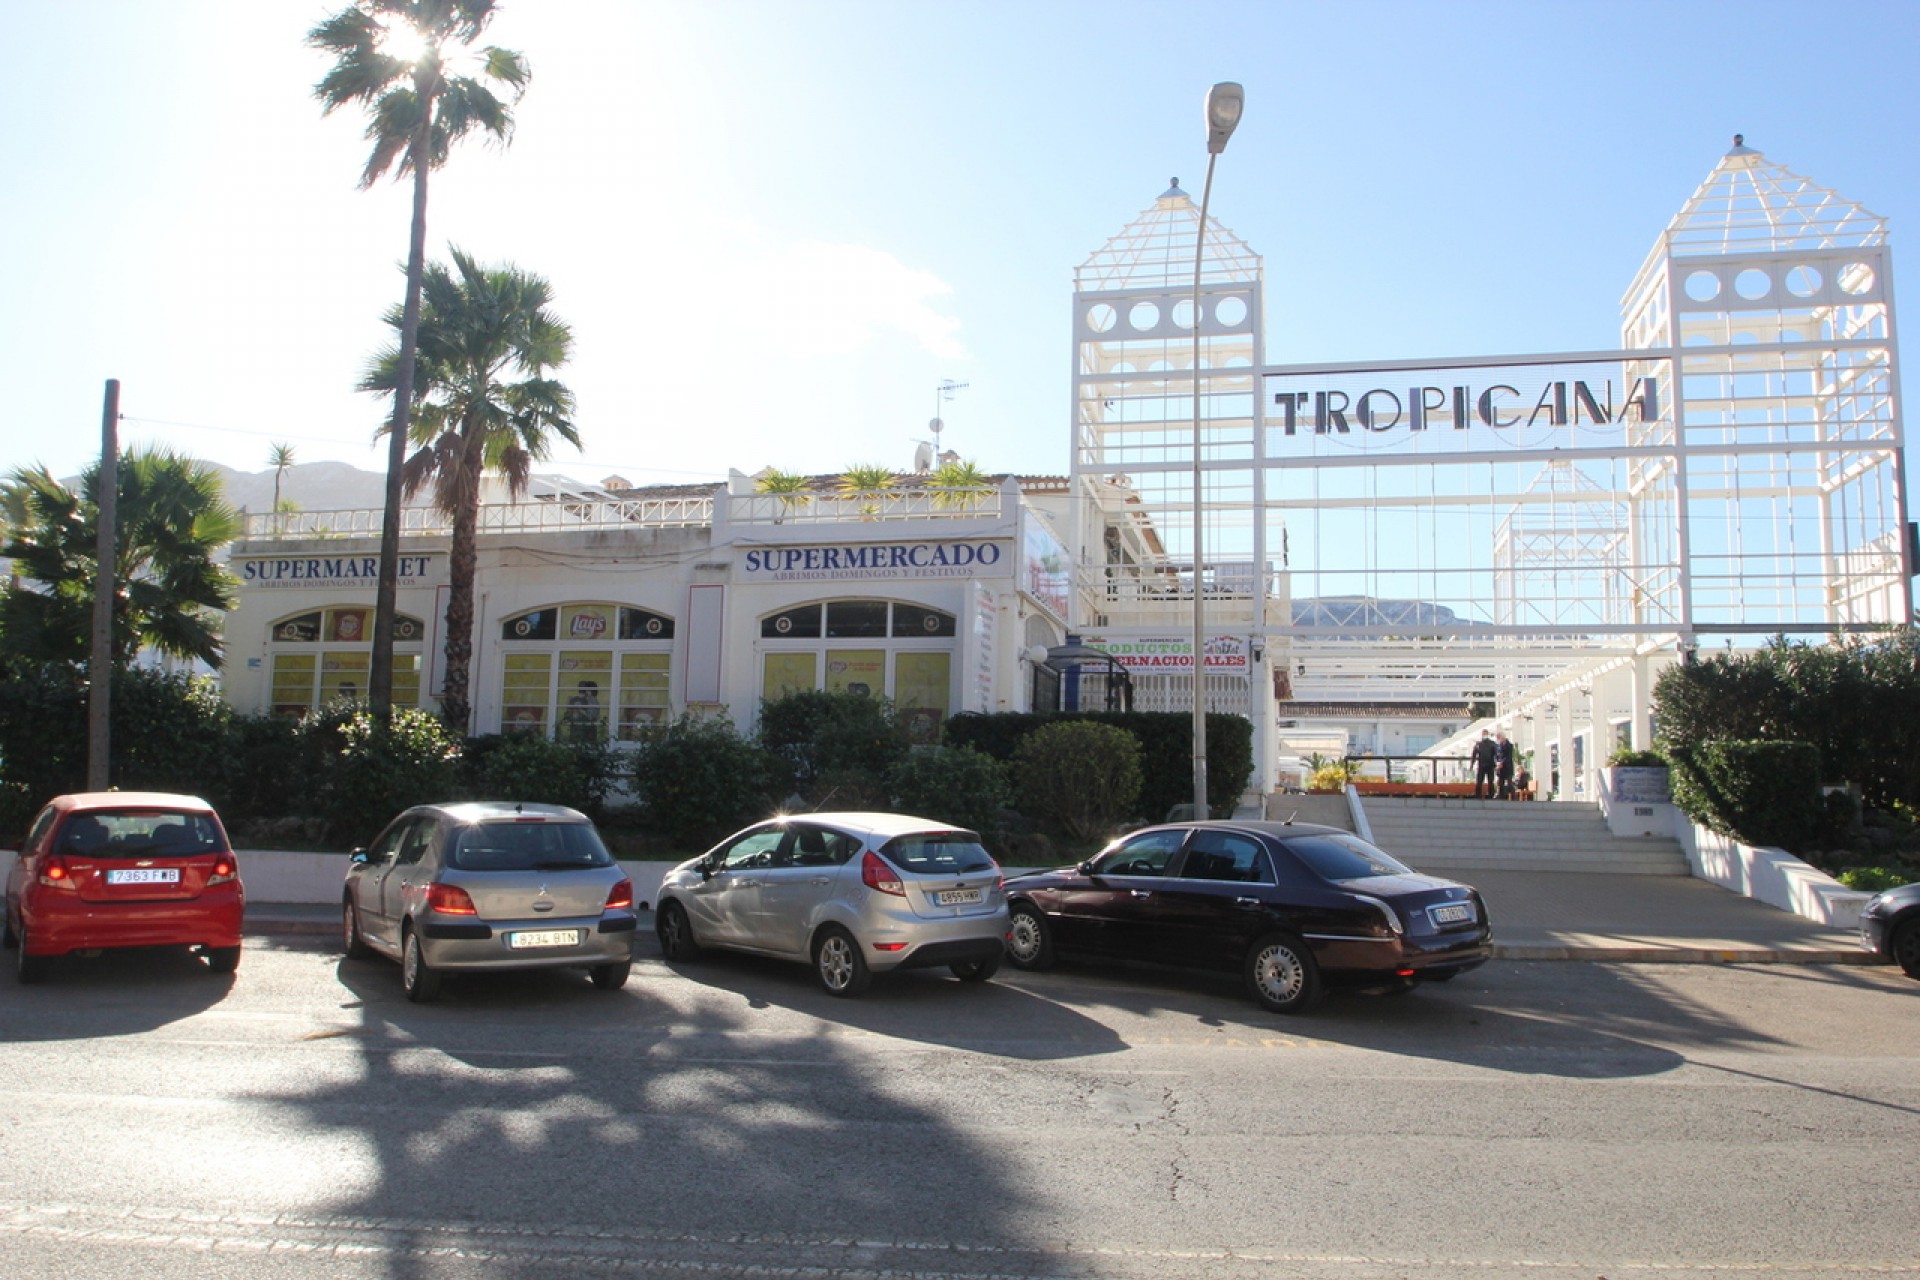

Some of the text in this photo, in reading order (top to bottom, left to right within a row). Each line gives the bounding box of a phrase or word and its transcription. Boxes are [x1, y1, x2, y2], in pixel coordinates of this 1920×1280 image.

[1274, 377, 1658, 436] TROPICANA
[745, 542, 1001, 572] SUPERMERCADO
[243, 557, 432, 580] SUPERMARET
[772, 566, 975, 581] ABRIMOS DOMINGOS Y FESTIVOS
[303, 578, 356, 588] DOMINGOS
[360, 578, 366, 587] Y
[116, 871, 149, 882] 7363
